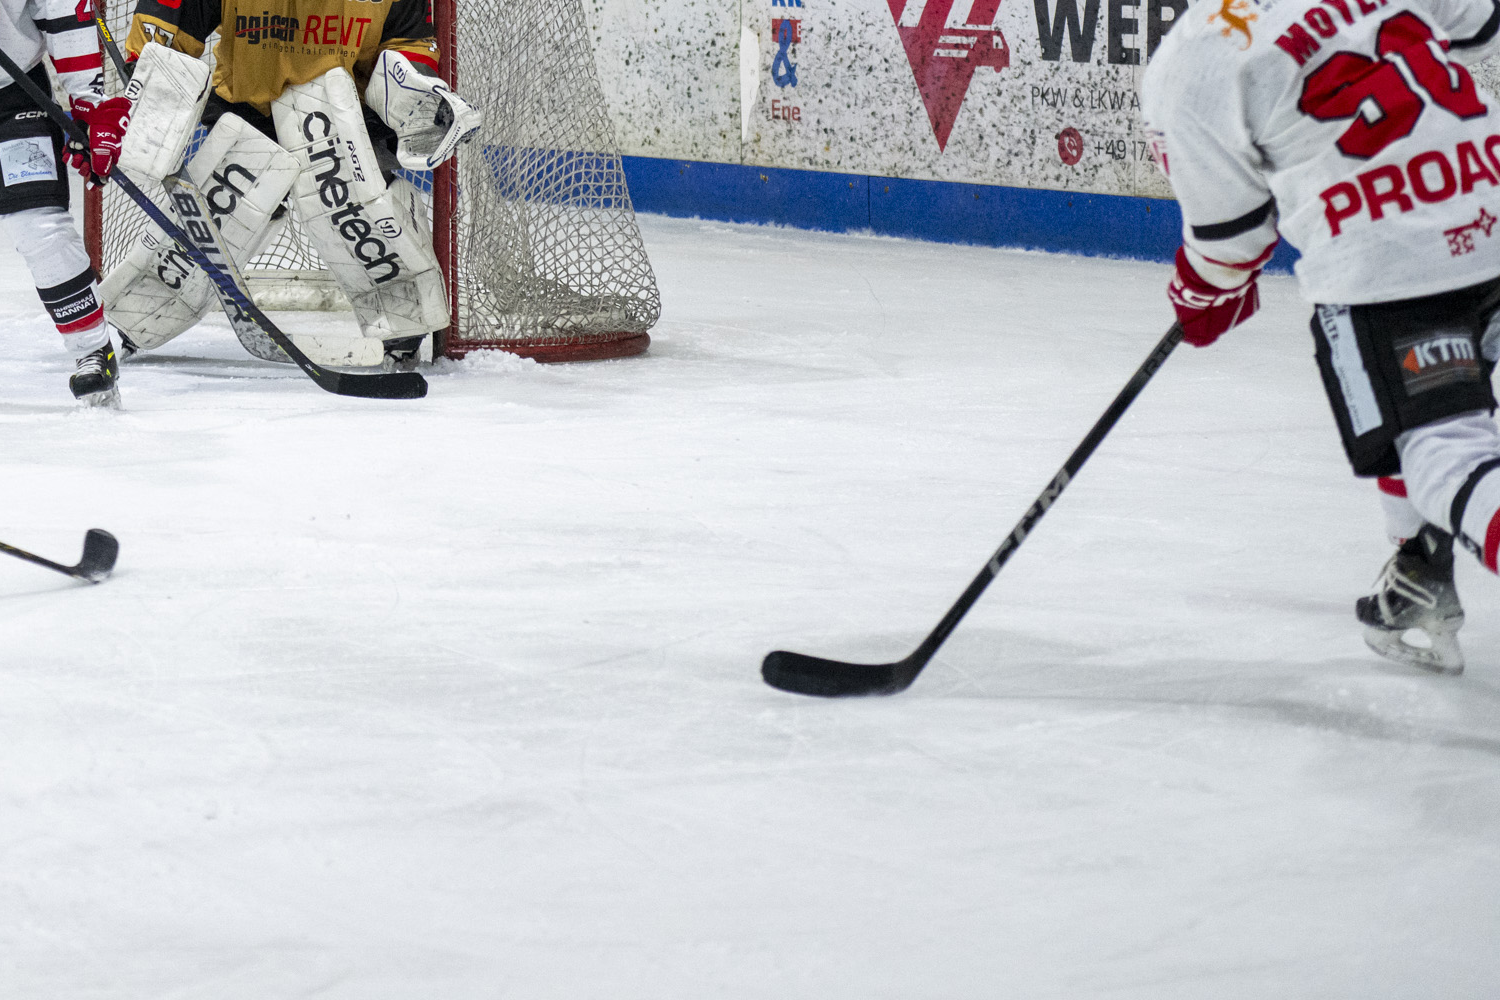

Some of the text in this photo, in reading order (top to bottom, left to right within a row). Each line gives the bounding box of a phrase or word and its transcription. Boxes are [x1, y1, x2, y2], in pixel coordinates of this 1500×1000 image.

[771, 18, 799, 89] &
[1031, 85, 1068, 109] PKW
[1072, 89, 1085, 109] &
[1090, 89, 1126, 110] LKW
[14, 110, 49, 120] CCM
[303, 110, 400, 285] cinetech
[55, 297, 95, 319] BANNAT
[1413, 337, 1475, 369] KTM
